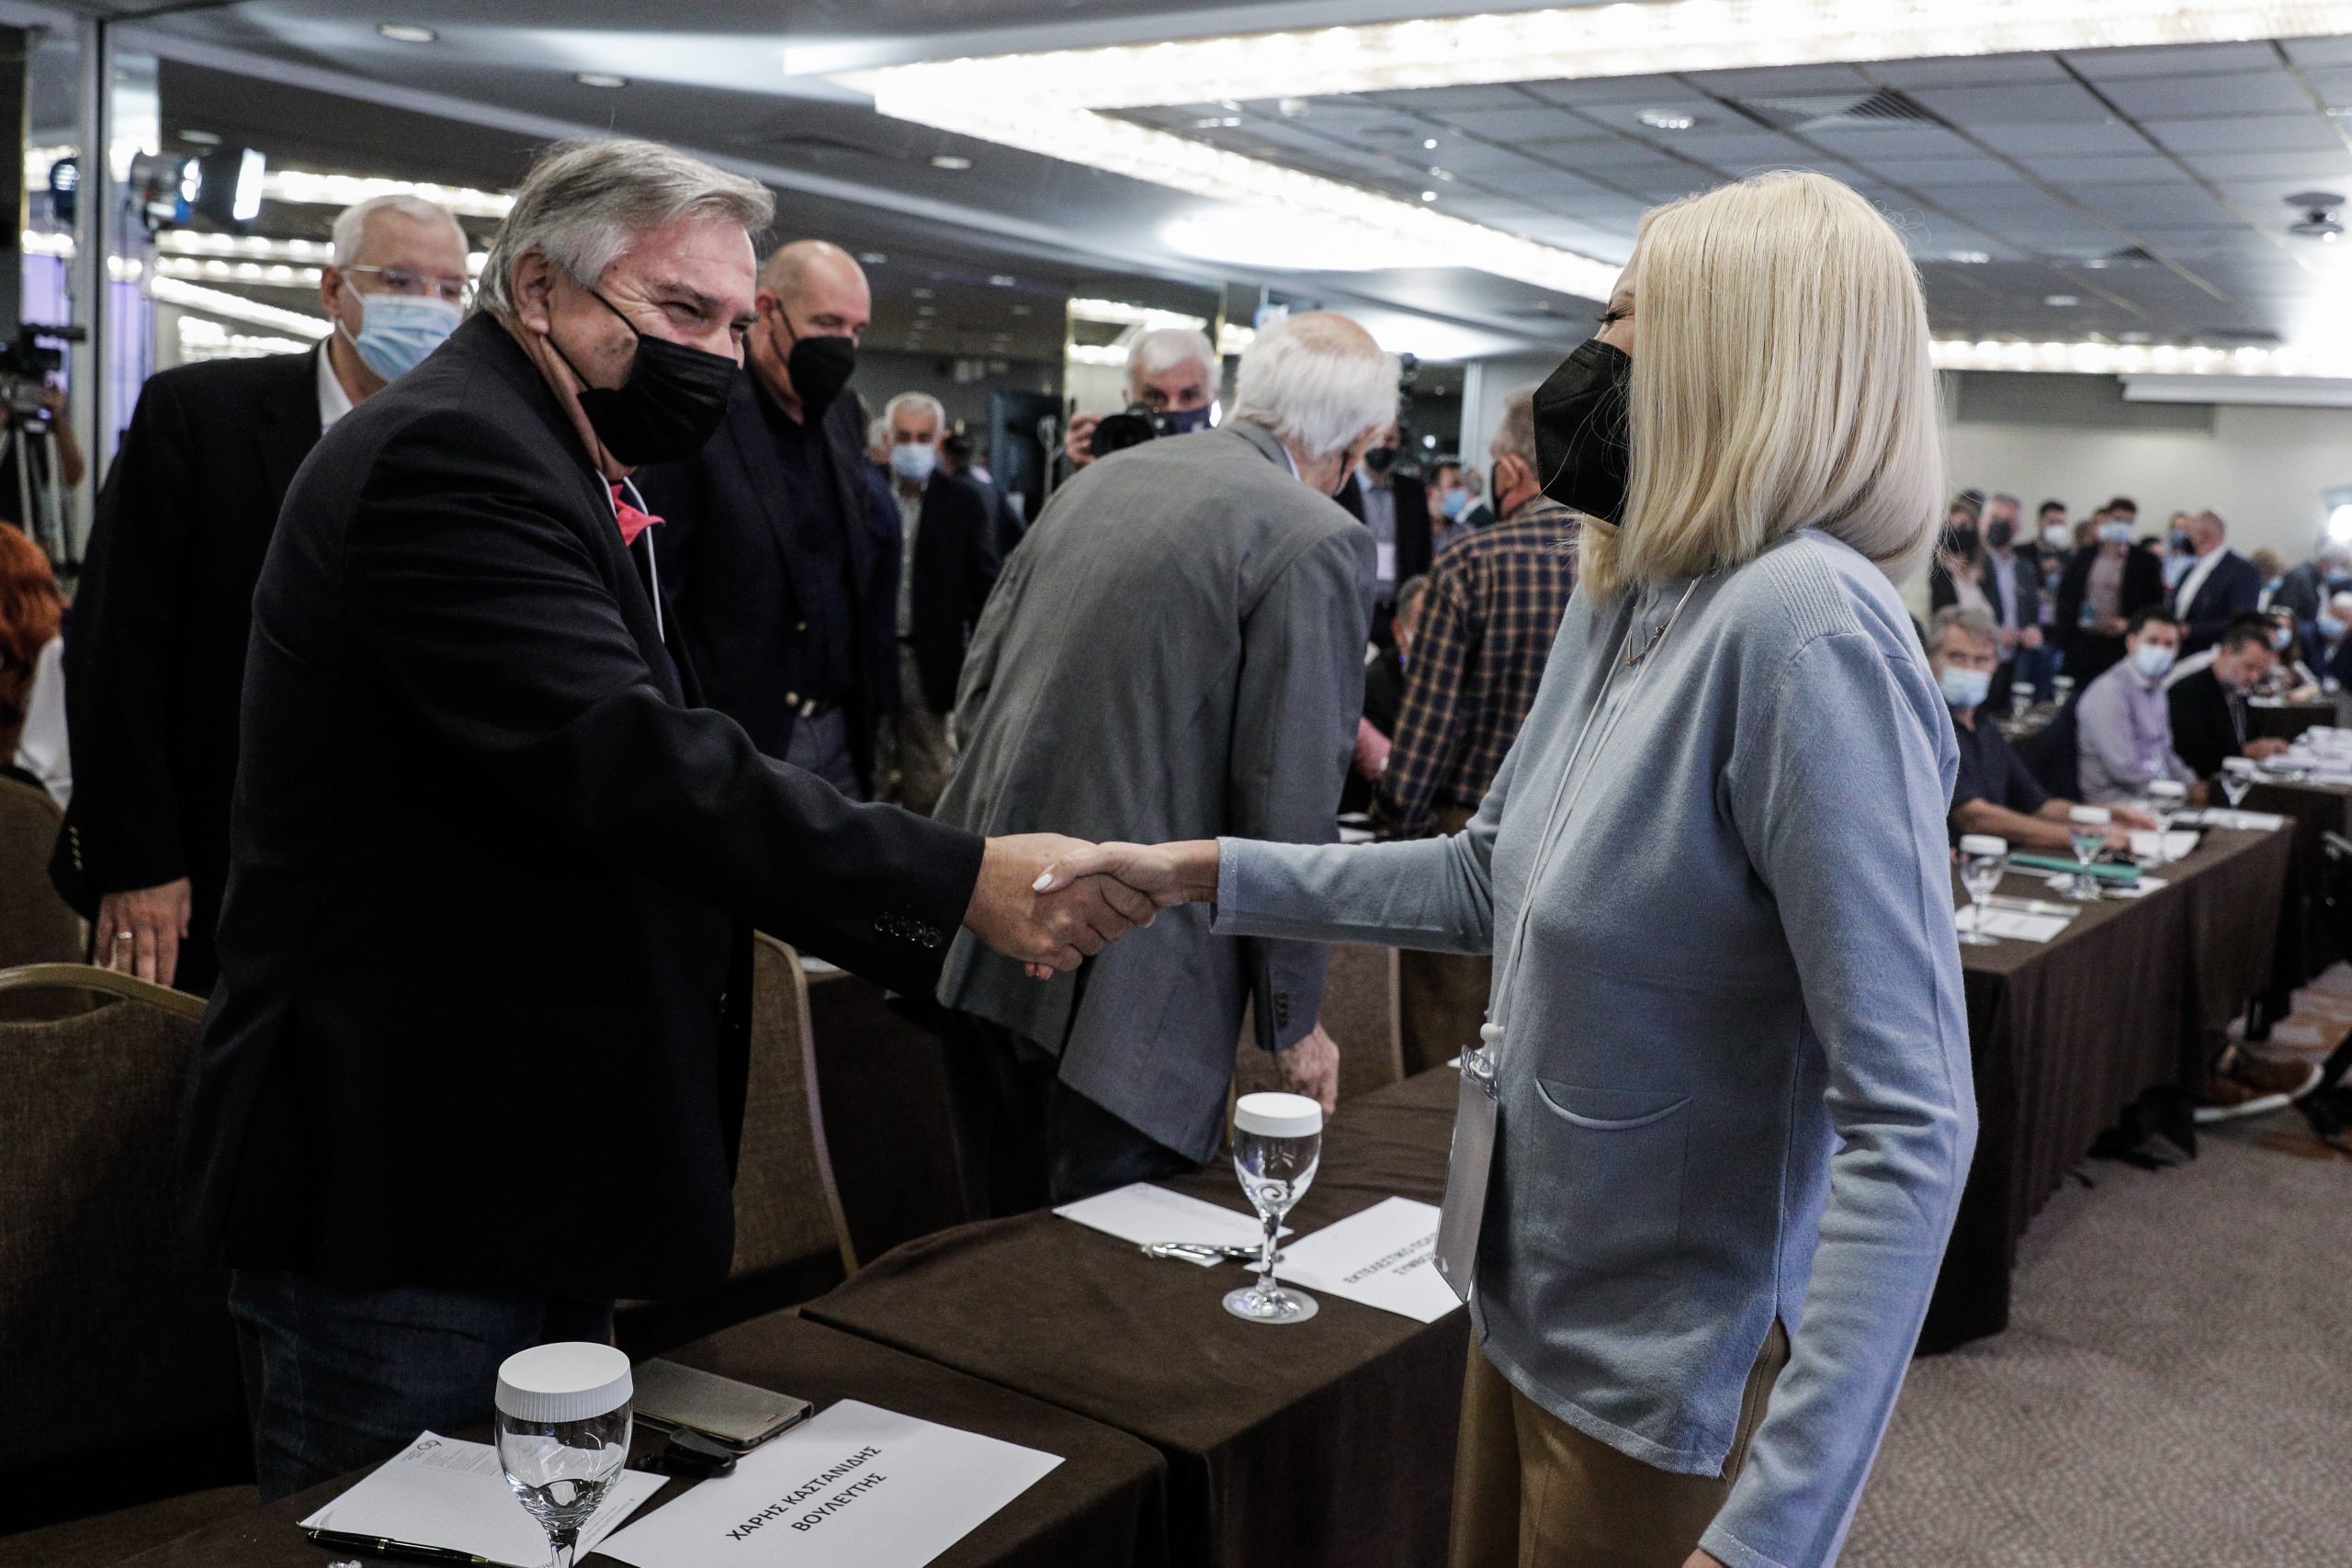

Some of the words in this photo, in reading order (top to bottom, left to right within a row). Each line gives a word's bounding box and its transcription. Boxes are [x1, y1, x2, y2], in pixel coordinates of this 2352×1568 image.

[725, 1504, 789, 1540] ΧΑΡΗΣ
[781, 1446, 882, 1505] ΚΑΣΤΑΝΙΔΗΣ
[791, 1472, 888, 1531] ΒΟΥΛΕΥΤΗΣ
